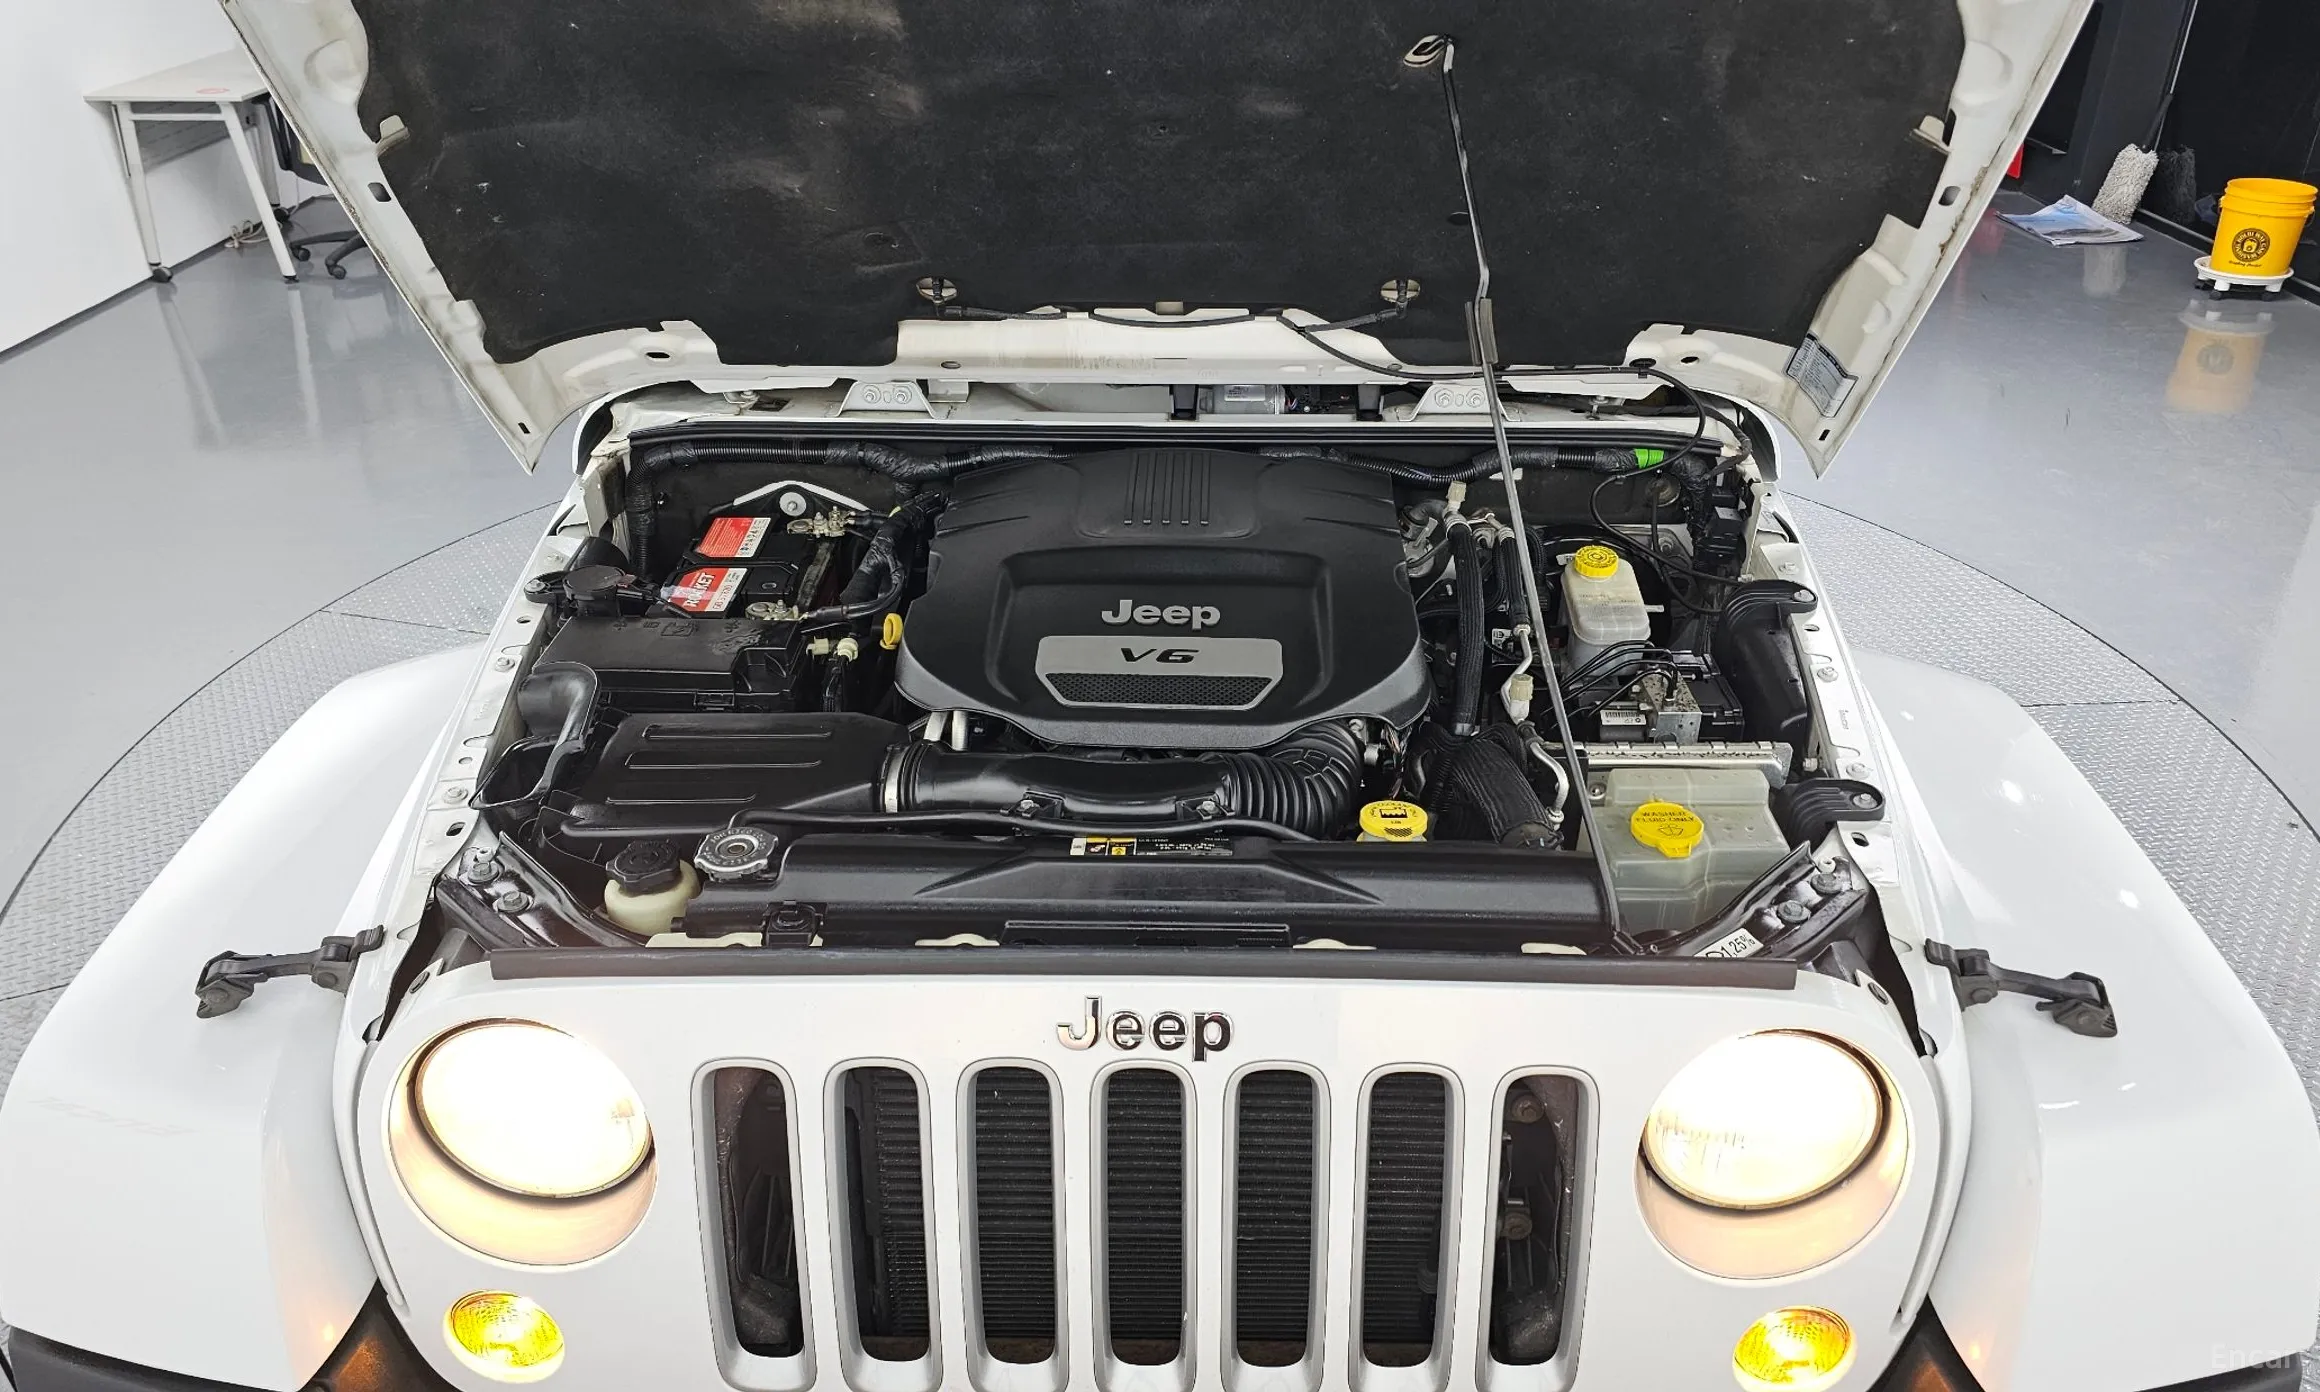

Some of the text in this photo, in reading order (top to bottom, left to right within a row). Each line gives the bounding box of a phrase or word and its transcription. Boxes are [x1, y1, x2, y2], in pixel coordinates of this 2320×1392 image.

[1101, 599, 1221, 631] Jeep
[1120, 647, 1200, 664] V6
[1056, 995, 1235, 1063] Jeep
